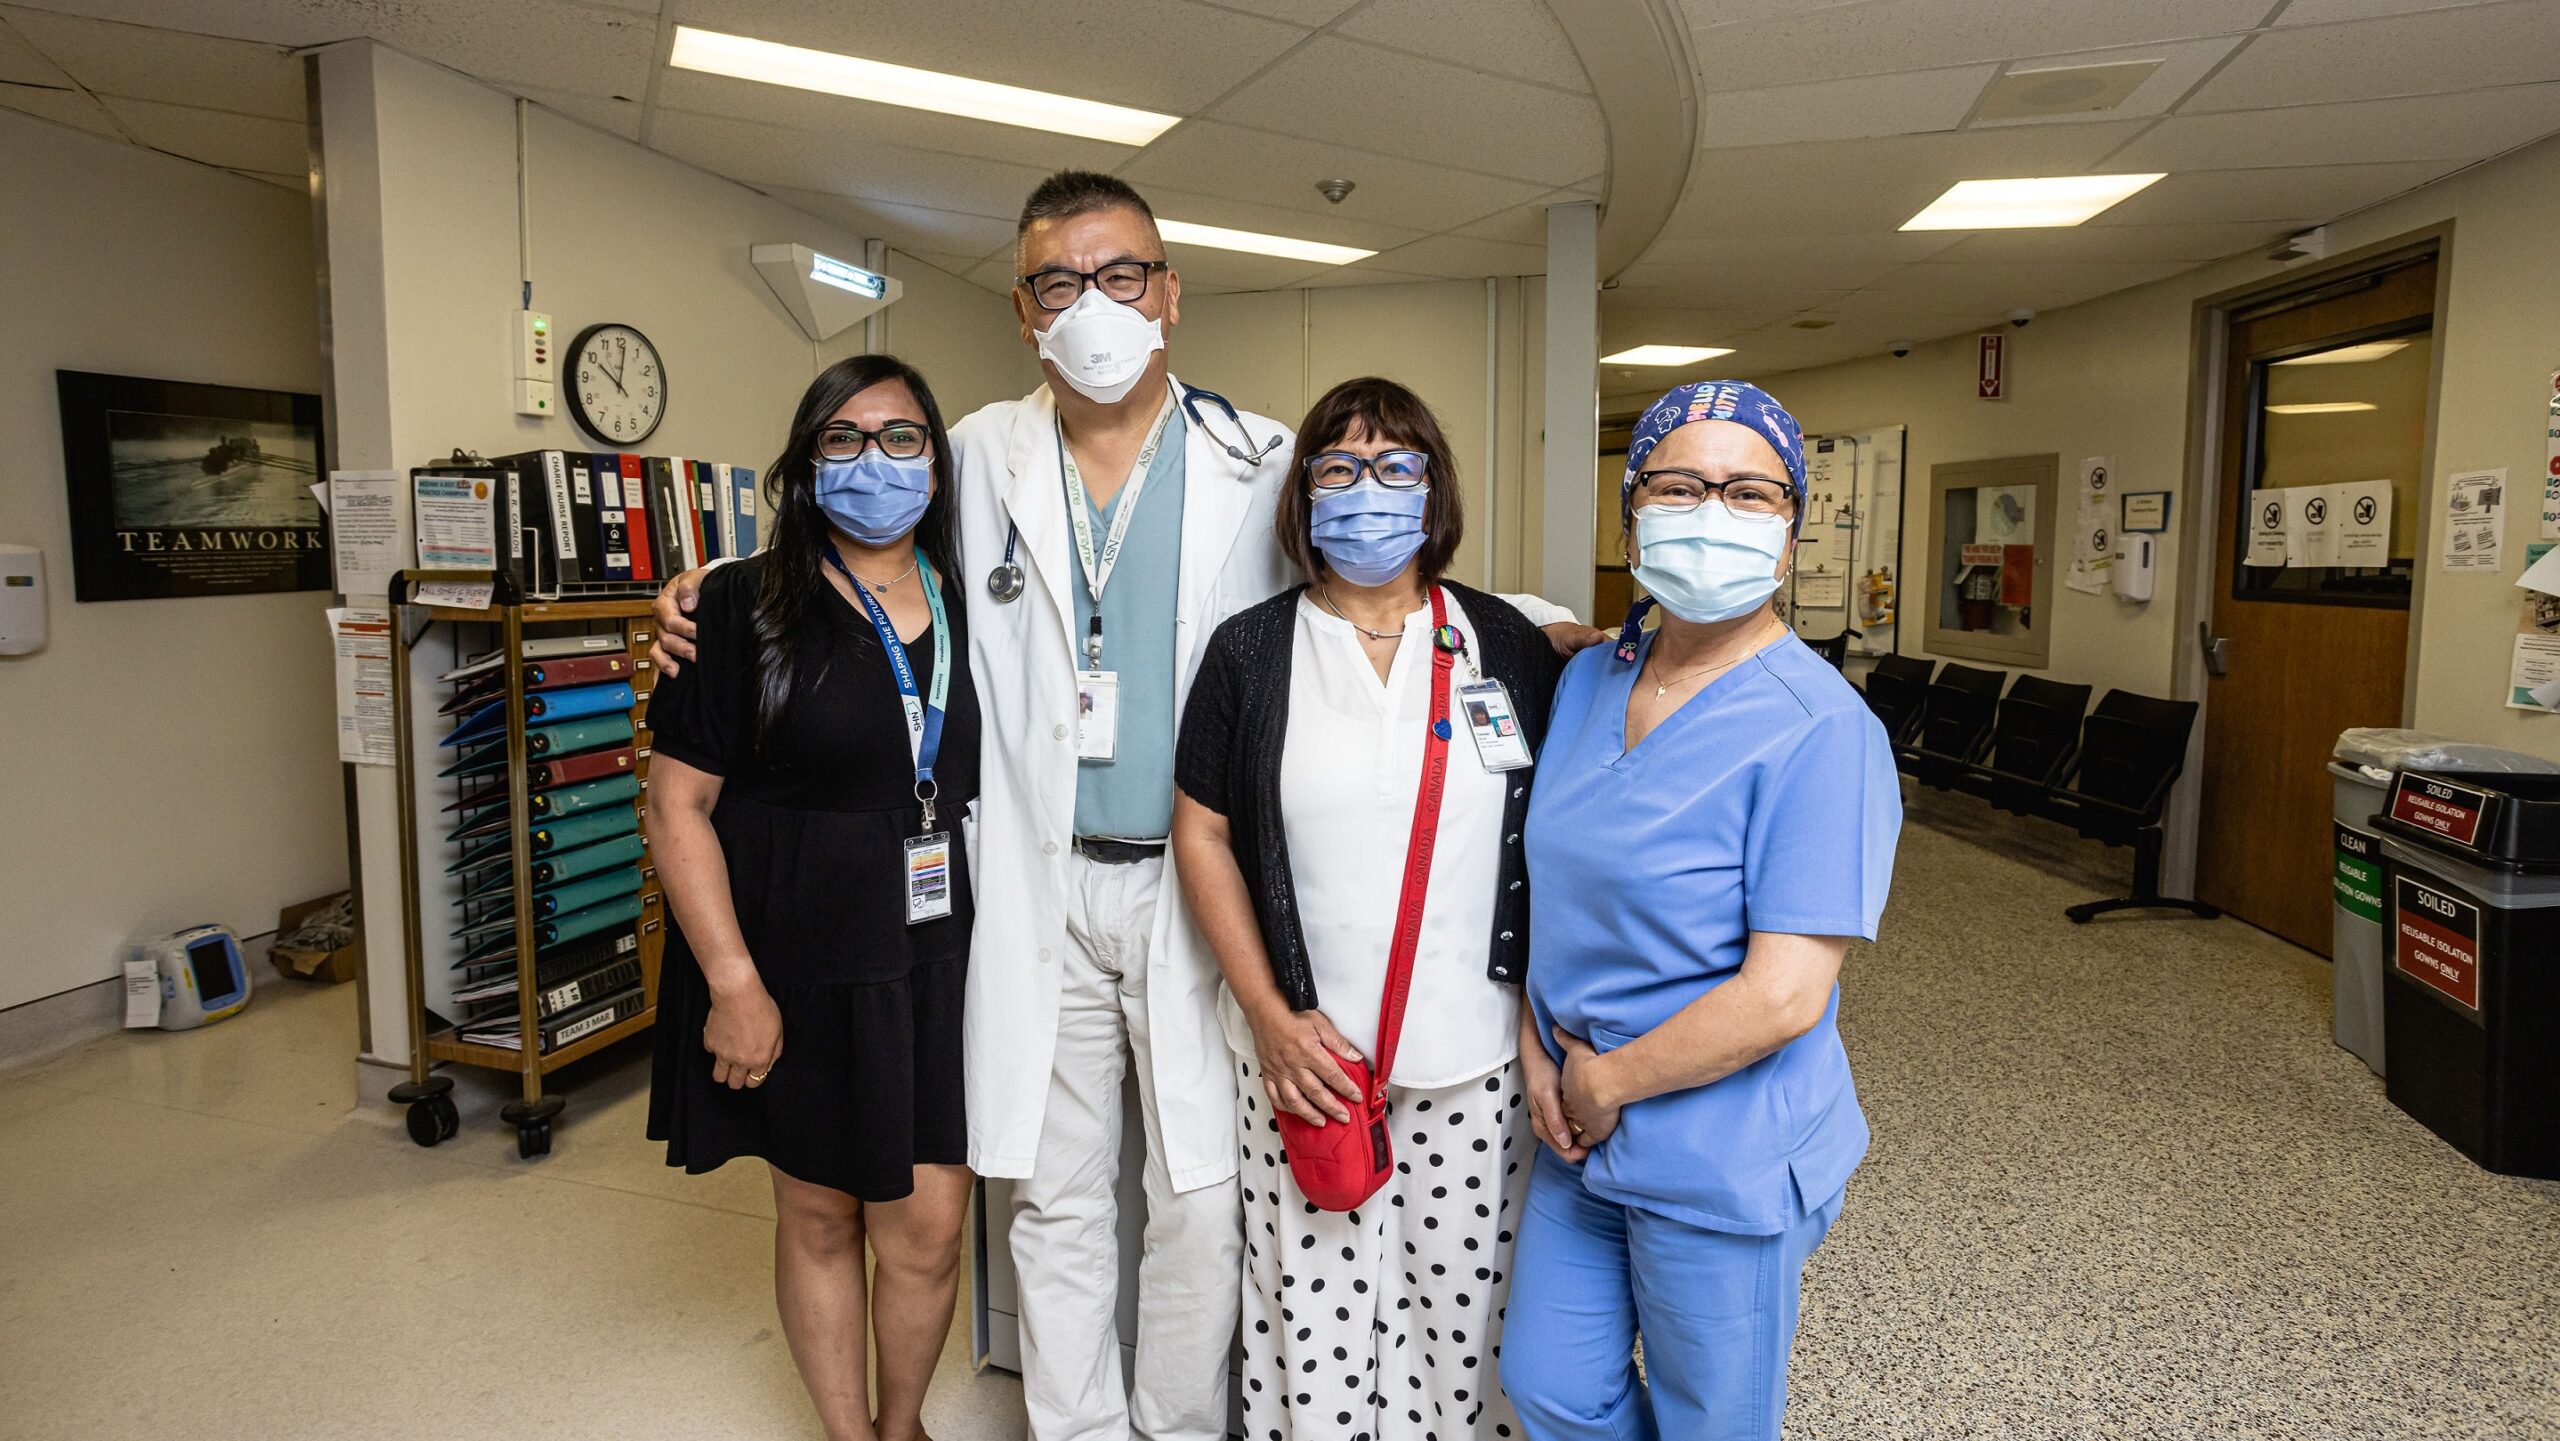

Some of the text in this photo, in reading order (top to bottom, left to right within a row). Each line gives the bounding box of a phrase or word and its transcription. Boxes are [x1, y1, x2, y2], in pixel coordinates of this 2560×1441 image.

[601, 339, 609, 350] 11
[615, 337, 626, 349] 12
[635, 348, 639, 359] 1
[587, 352, 597, 364] 10
[1090, 351, 1112, 365] 3M
[582, 371, 589, 383] 9
[643, 365, 650, 377] 2
[586, 393, 593, 405] 8
[648, 386, 654, 397] 3
[642, 405, 649, 416] 4
[1686, 385, 1716, 423] HELLO
[1711, 386, 1740, 420] KITTY
[598, 411, 605, 423] 7
[614, 421, 621, 432] 6
[630, 418, 637, 430] 5
[1138, 446, 1155, 468] ASN
[1066, 464, 1081, 506] genzyme
[551, 456, 571, 553] CHARGE NURSE REPORT
[511, 513, 520, 553] CATALOG
[1074, 520, 1093, 566] genzyme
[1103, 539, 1119, 566] ASN
[865, 593, 886, 625] FUTURE
[882, 626, 896, 644] THE
[891, 646, 912, 689] SHAPING
[911, 711, 922, 732] SHN
[1428, 756, 1444, 813] CANADA
[2426, 783, 2453, 799] SOILED
[2408, 794, 2466, 819] REUSABLE ISOLATION
[2413, 811, 2451, 830] GOWNS ONLY
[2340, 833, 2366, 854] CLEAN
[1415, 827, 1433, 885] CANADA
[2354, 889, 2382, 908] GOWNS
[2417, 890, 2456, 918] SOILED
[1403, 900, 1422, 958] CANADA
[2401, 923, 2473, 965] REUSABLE ISOLATION
[2414, 949, 2460, 981] GOWNS ONLY
[560, 1025, 584, 1040] TEAM
[591, 1012, 611, 1026] MAR
